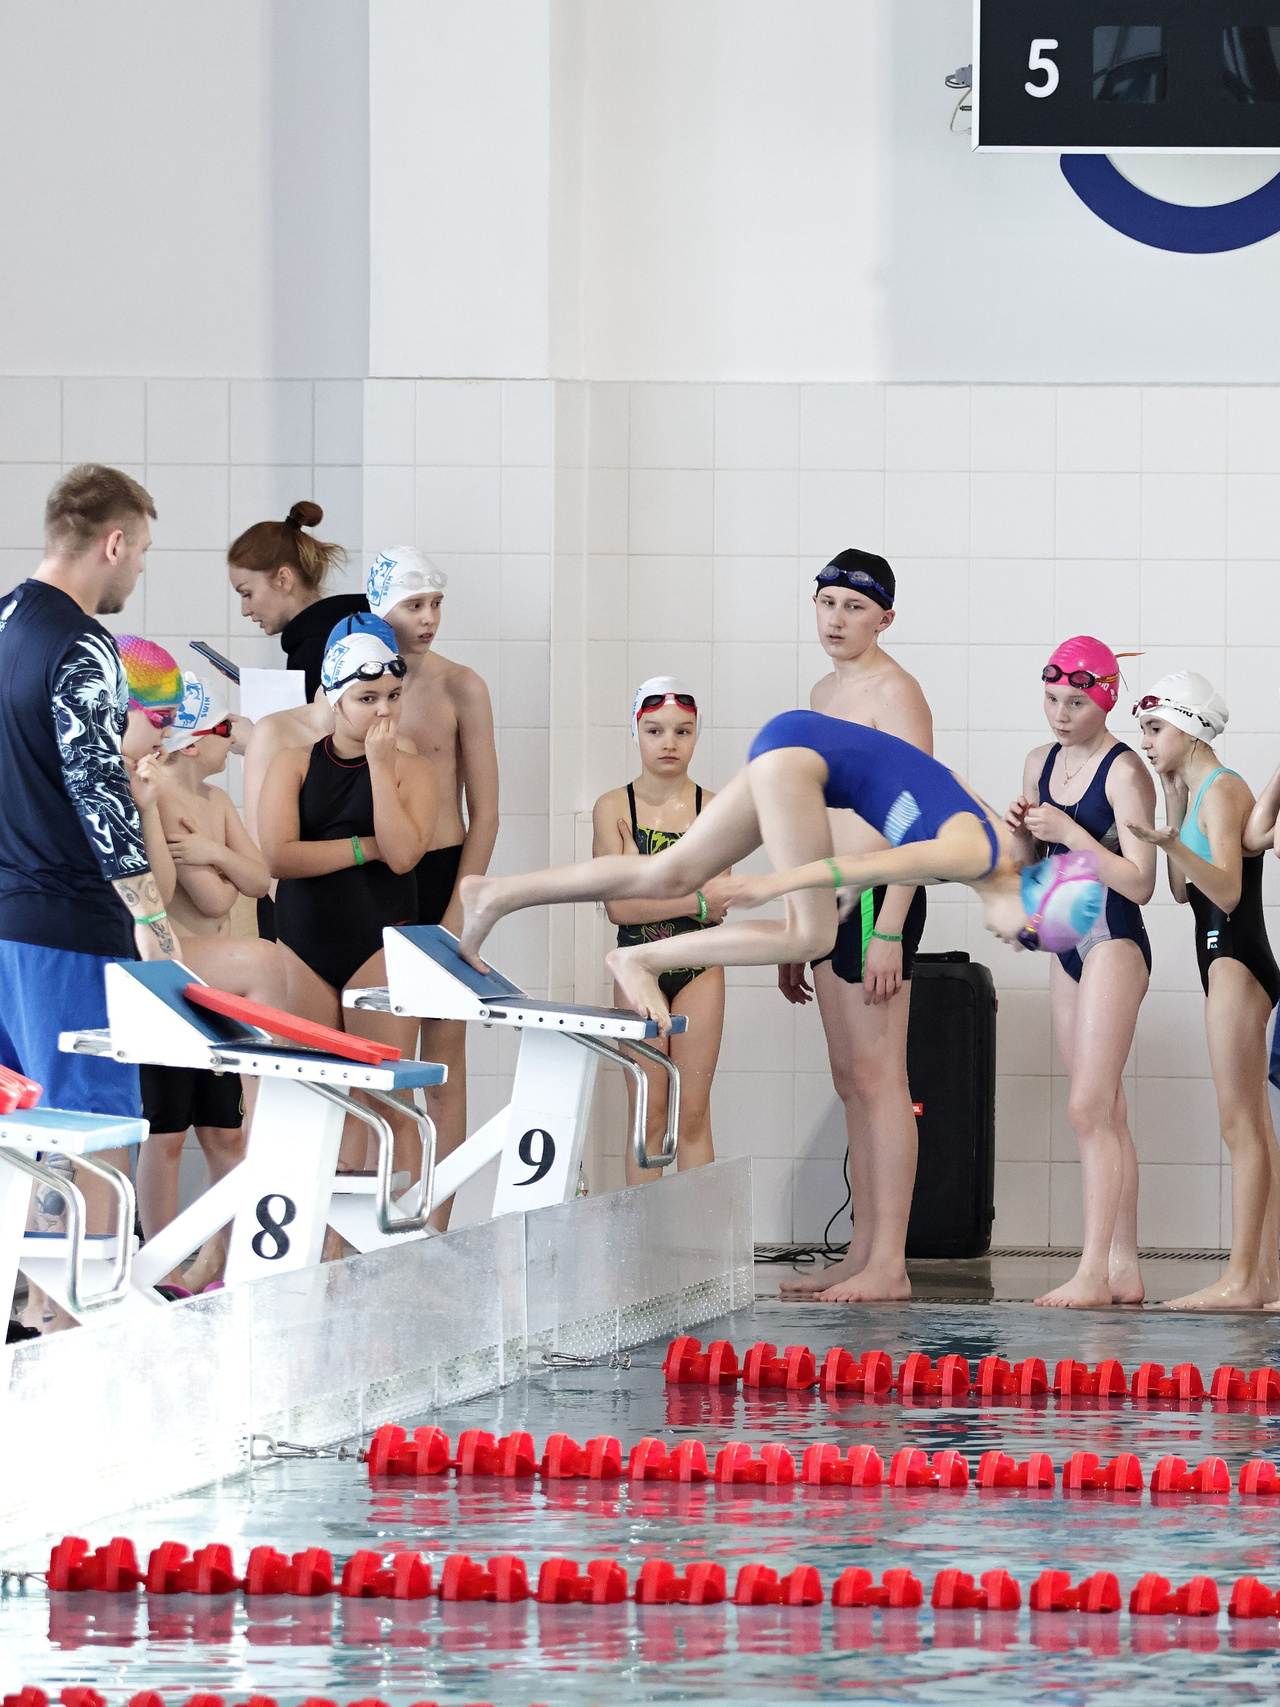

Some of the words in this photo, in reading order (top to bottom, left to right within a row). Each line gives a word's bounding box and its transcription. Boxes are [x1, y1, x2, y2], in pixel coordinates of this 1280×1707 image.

[1025, 38, 1059, 98] 5
[382, 575, 394, 596] SWIM
[333, 660, 346, 681] SWIM
[200, 696, 211, 718] SWIM
[512, 1128, 556, 1186] 9
[252, 1194, 297, 1260] 8
